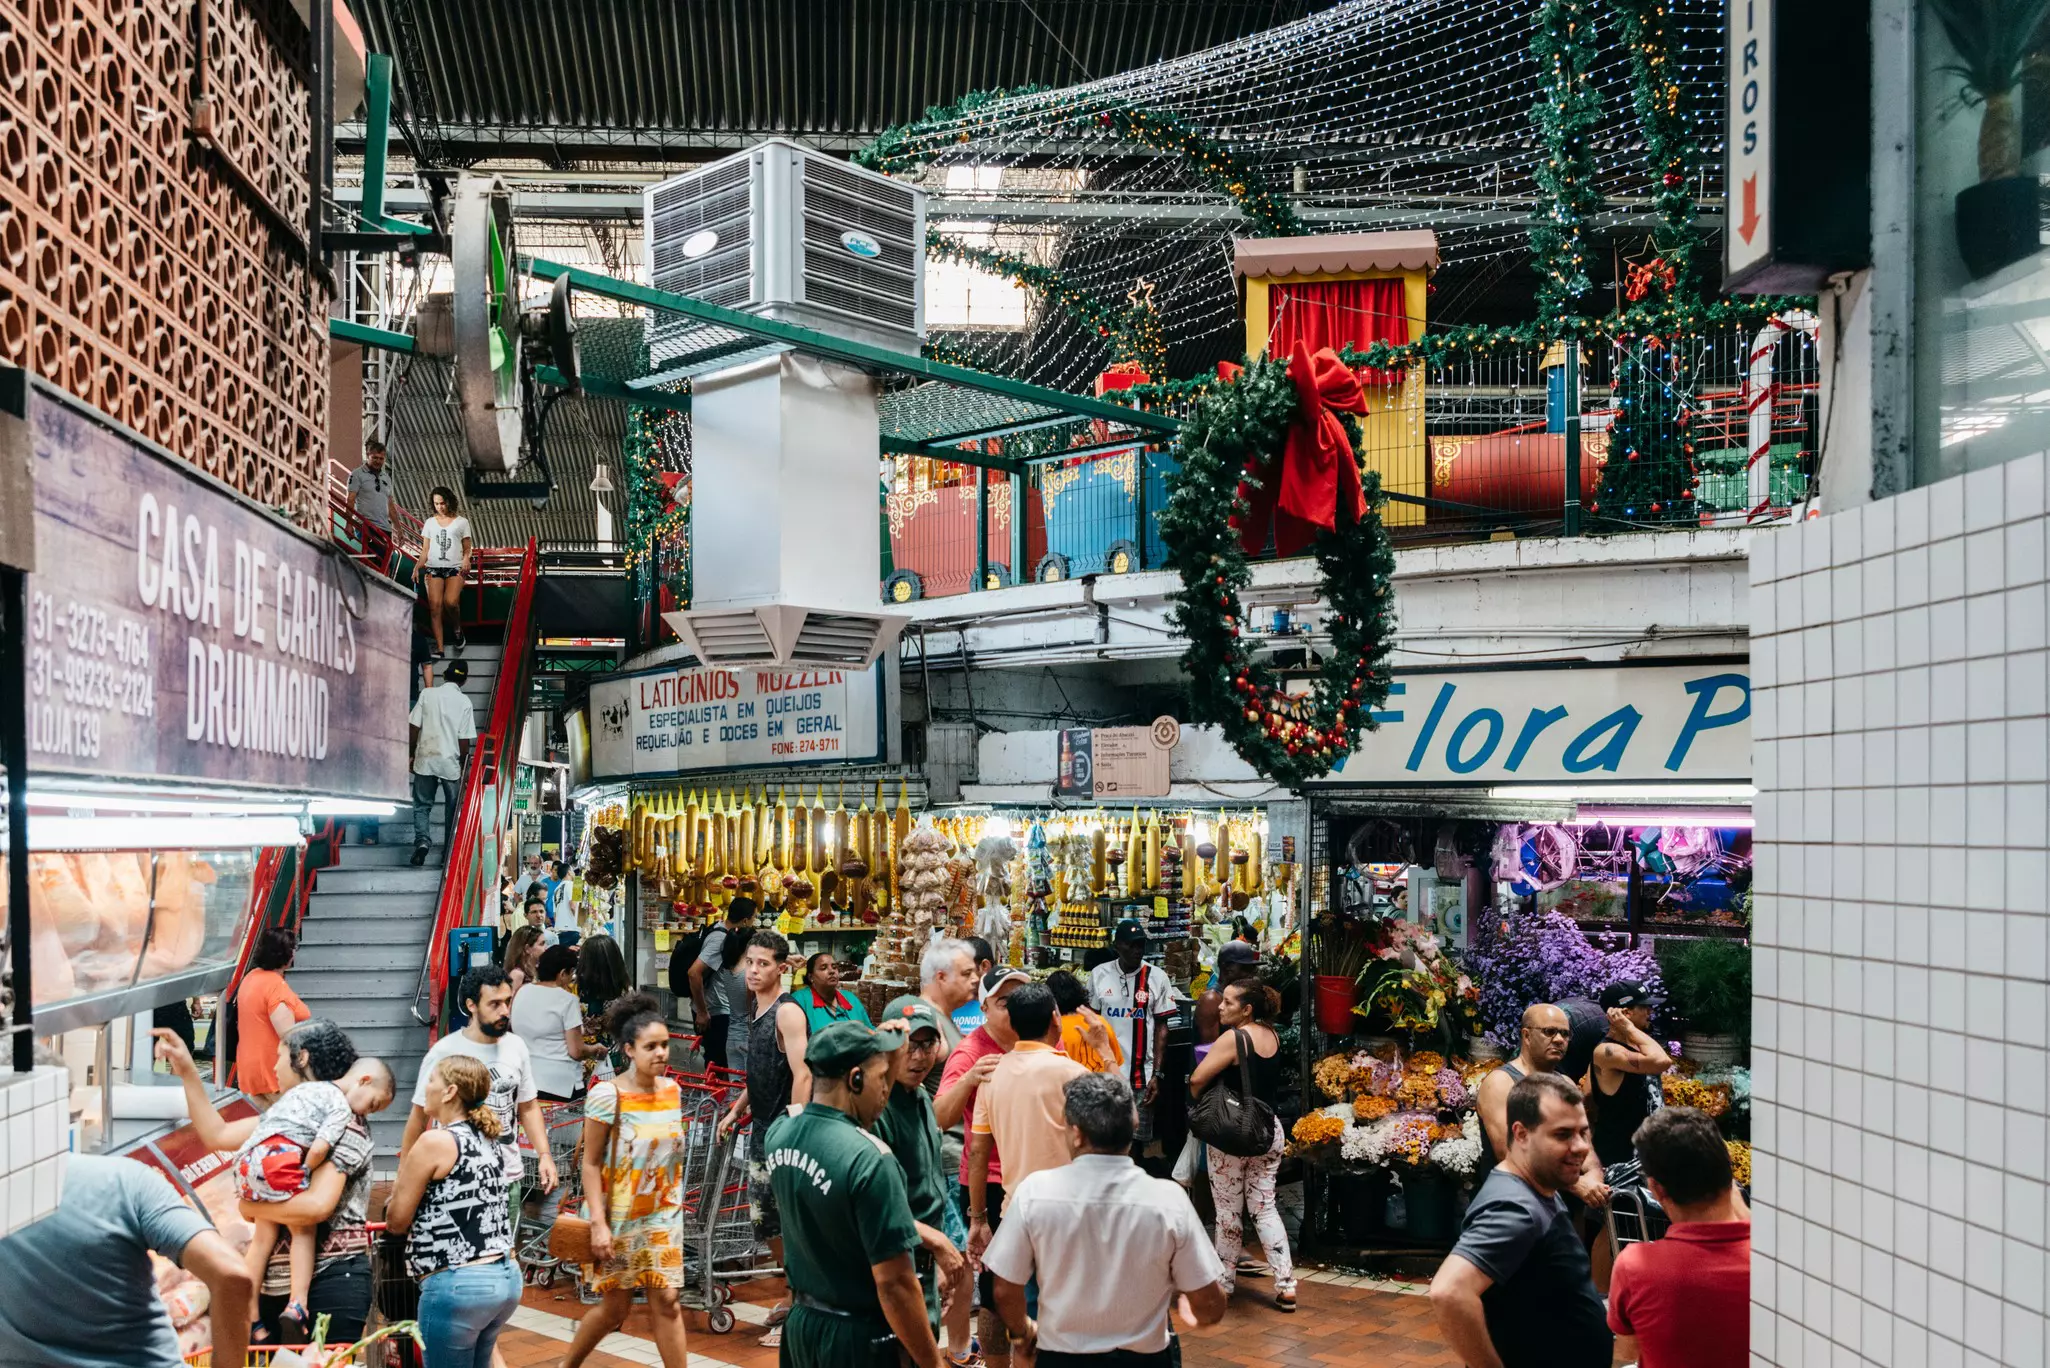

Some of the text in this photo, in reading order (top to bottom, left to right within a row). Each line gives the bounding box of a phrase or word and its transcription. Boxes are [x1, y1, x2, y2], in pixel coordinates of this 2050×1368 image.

[138, 492, 357, 675] CASA DE CARNES
[33, 590, 149, 667] 31-3273-4764
[32, 646, 153, 718] 31-99233-2124
[187, 636, 329, 760] DRUMMOND
[32, 702, 101, 759] LOJA 139
[636, 714, 842, 752] REQUEIJÃO E DOCES EM GERAL
[649, 693, 822, 729] ESPECIALISTA EM QUEIJOS
[1106, 1006, 1145, 1018] CAIXA
[765, 1148, 832, 1195] SEGURANÇA
